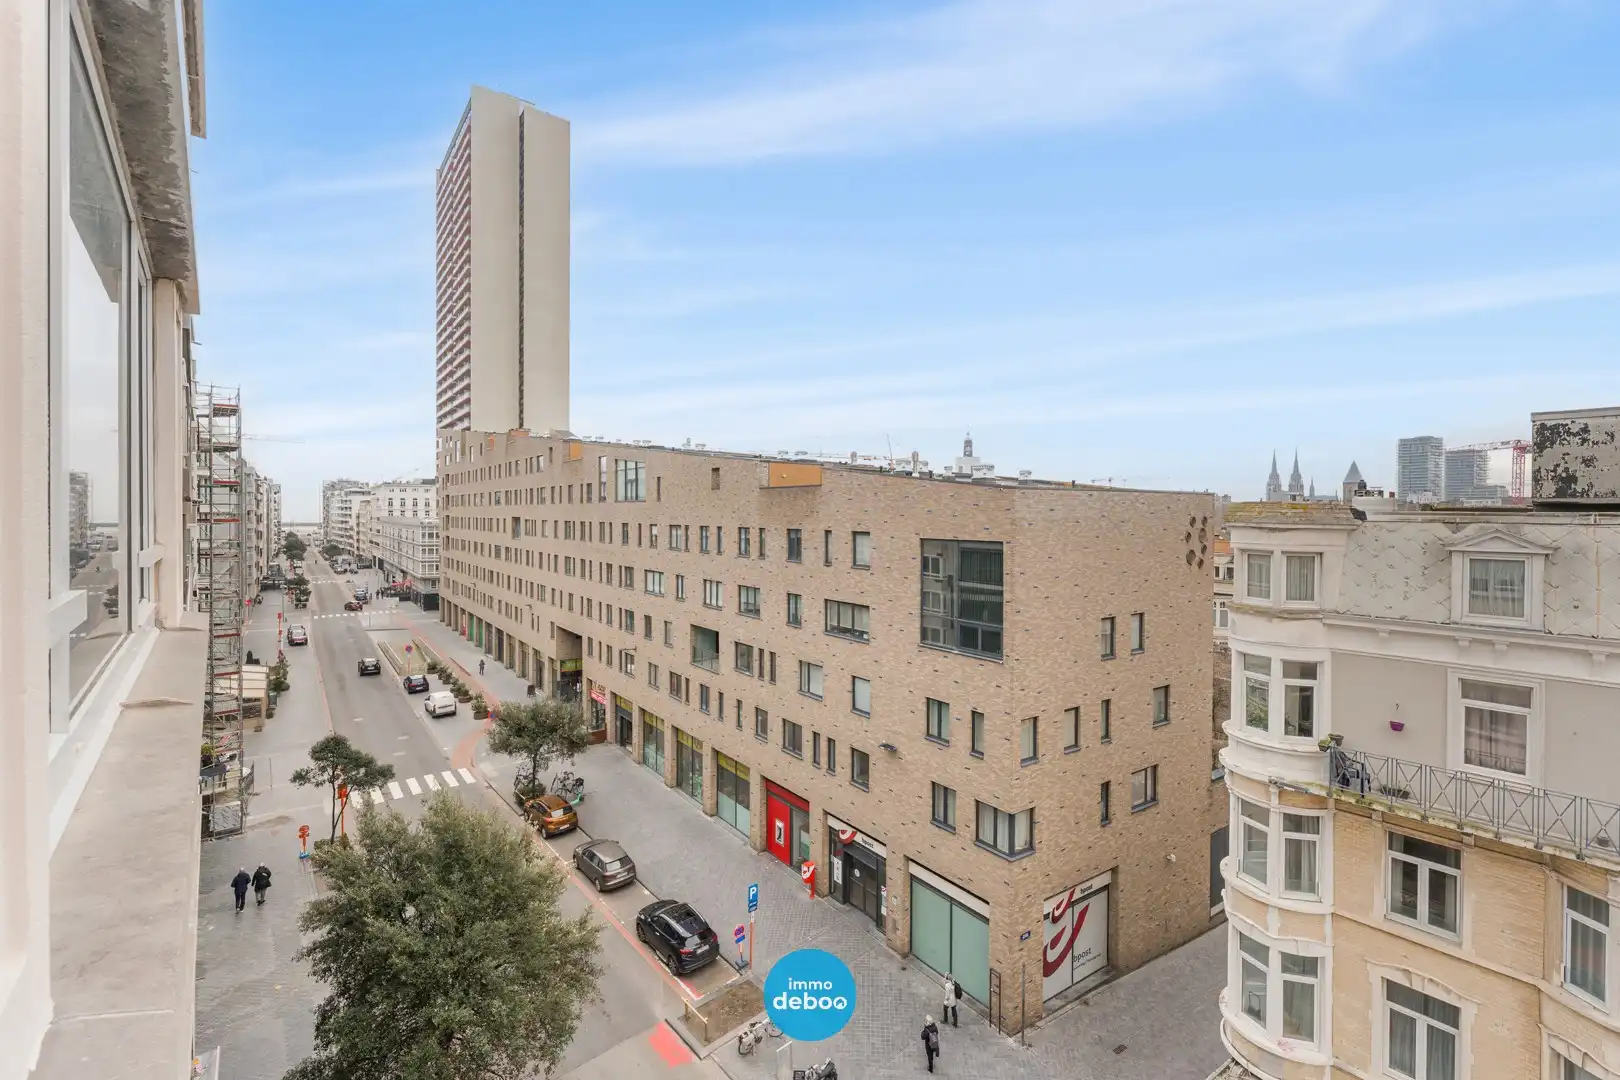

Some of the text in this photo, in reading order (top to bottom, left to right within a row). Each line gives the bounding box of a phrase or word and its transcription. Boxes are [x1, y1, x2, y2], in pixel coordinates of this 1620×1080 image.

[861, 837, 874, 849] bpost
[749, 886, 757, 900] P
[1080, 884, 1093, 895] bpost
[1073, 947, 1092, 963] bpost
